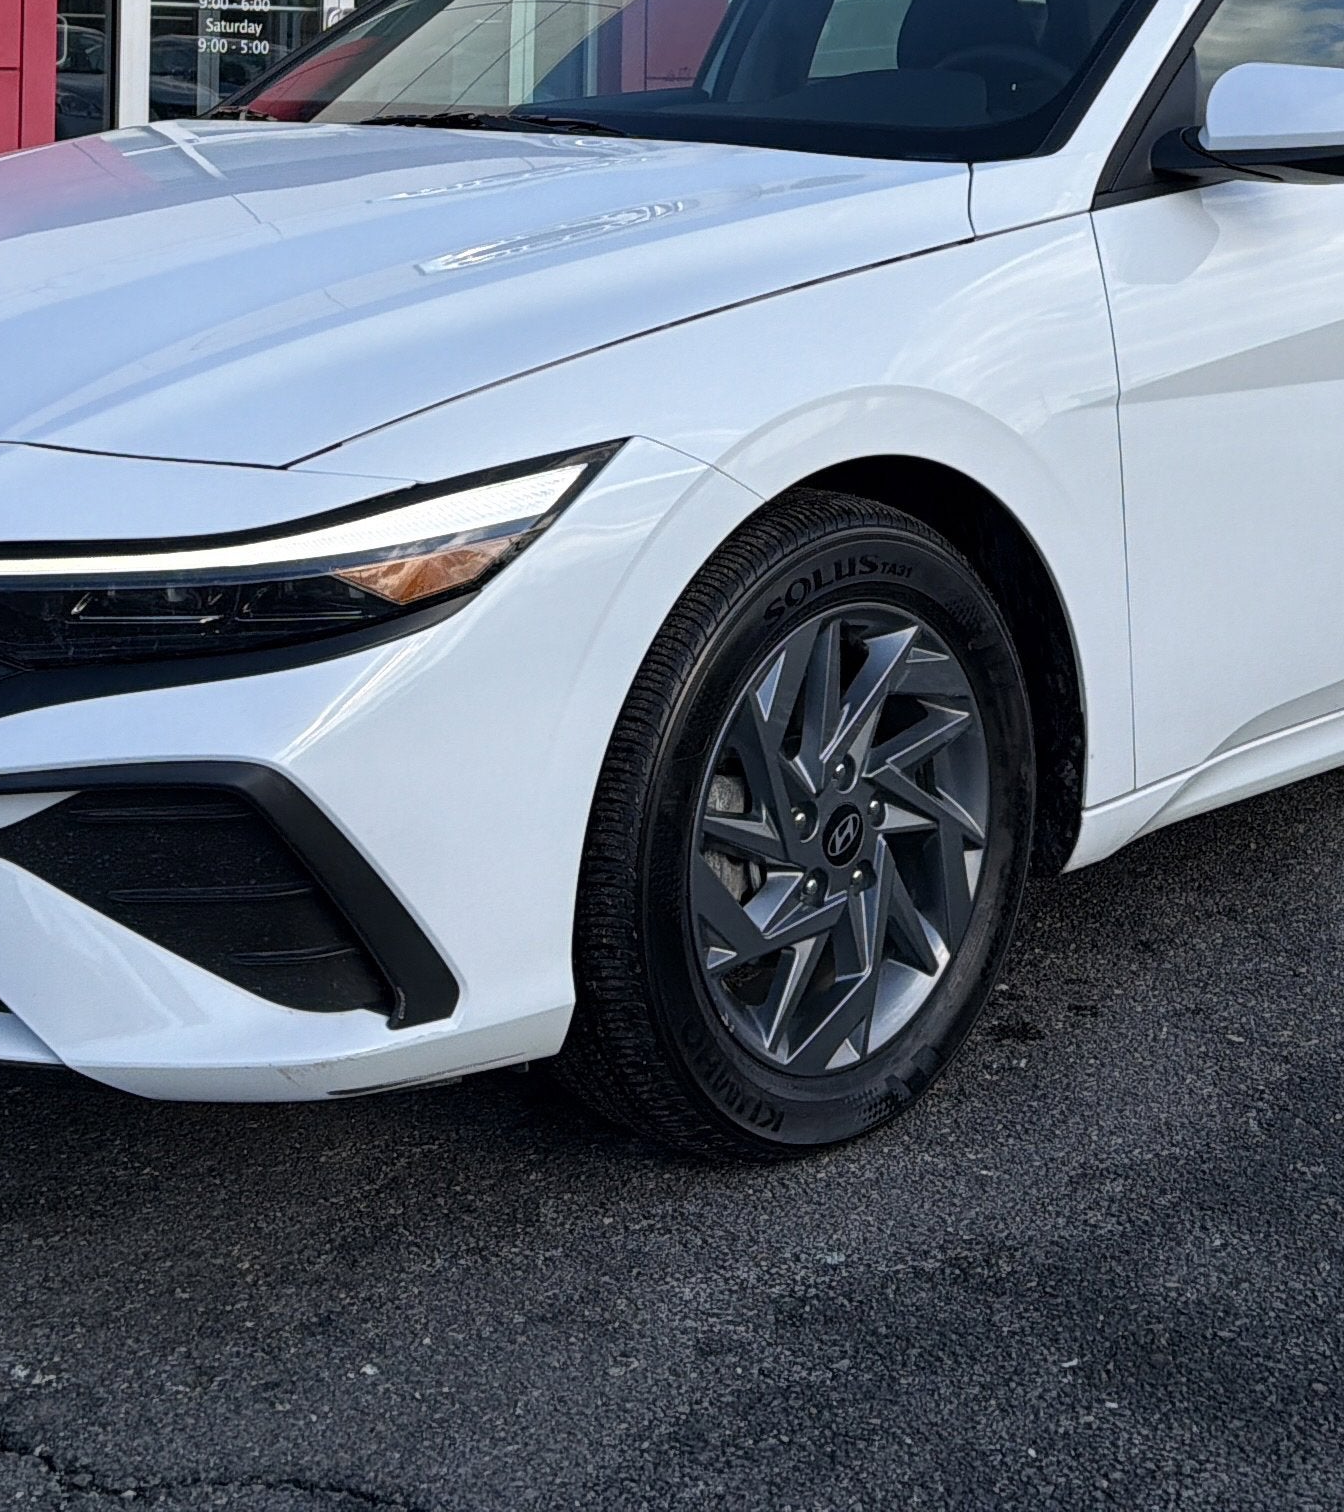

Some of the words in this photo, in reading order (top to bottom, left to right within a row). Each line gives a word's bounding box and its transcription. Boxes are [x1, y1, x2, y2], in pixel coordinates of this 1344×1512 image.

[205, 17, 263, 37] Saturday
[197, 39, 228, 54] 9:00
[240, 39, 270, 55] 5:00
[762, 553, 879, 624] SOLUS
[879, 561, 913, 579] TA31
